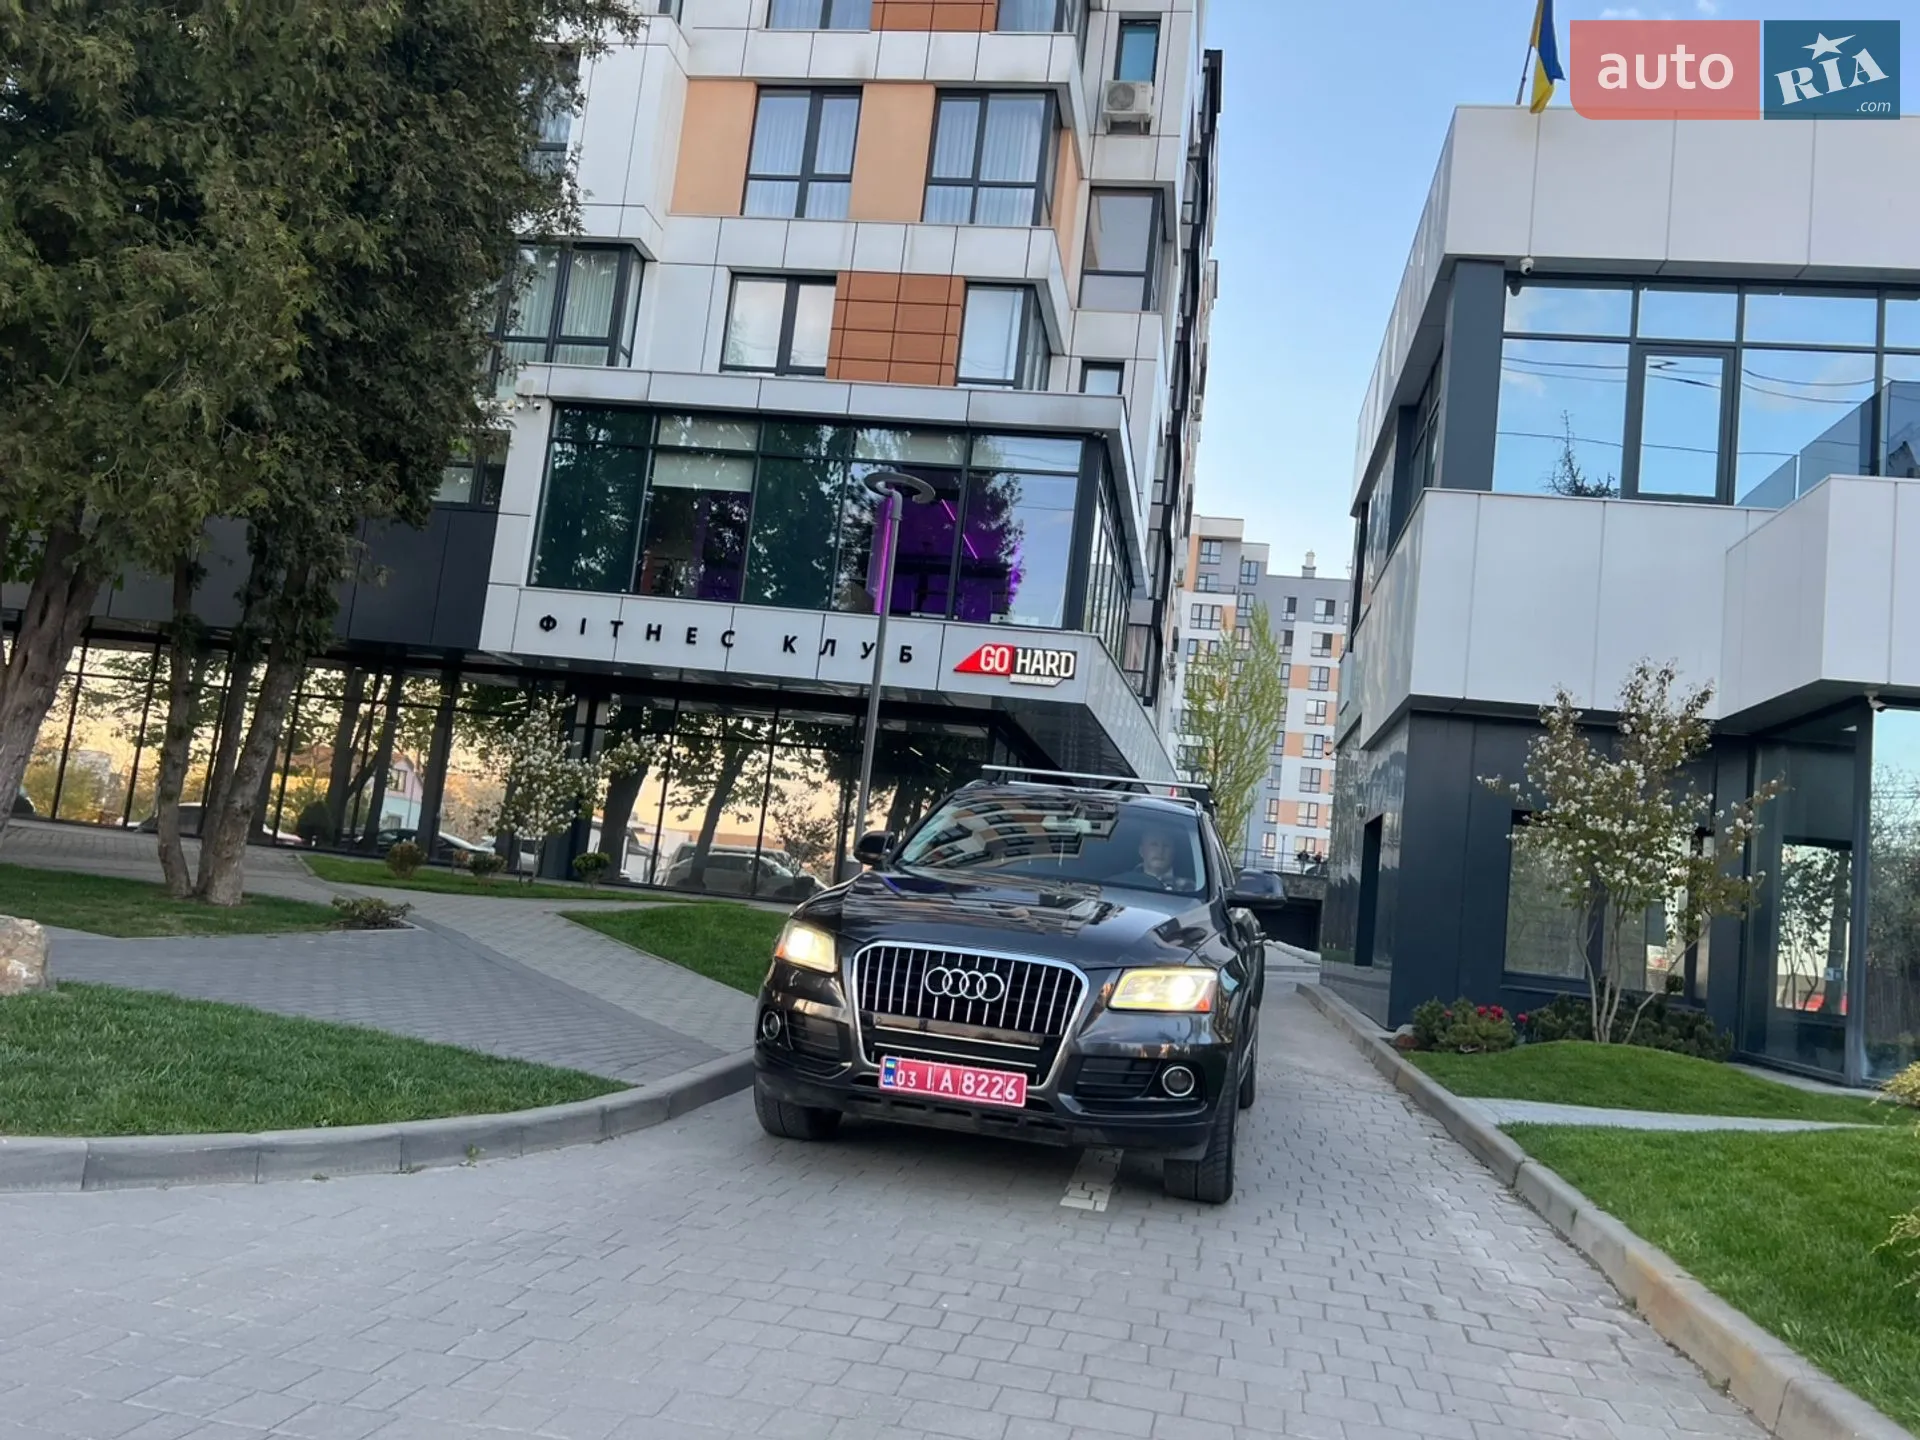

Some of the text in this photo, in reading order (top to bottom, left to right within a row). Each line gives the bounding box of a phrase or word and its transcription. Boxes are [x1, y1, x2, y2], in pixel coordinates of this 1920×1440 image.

[539, 614, 912, 663] ФІТНЕС КЛУБ
[980, 645, 1075, 678] GO HARD
[896, 1070, 917, 1087] 03
[961, 1073, 1018, 1100] 8226
